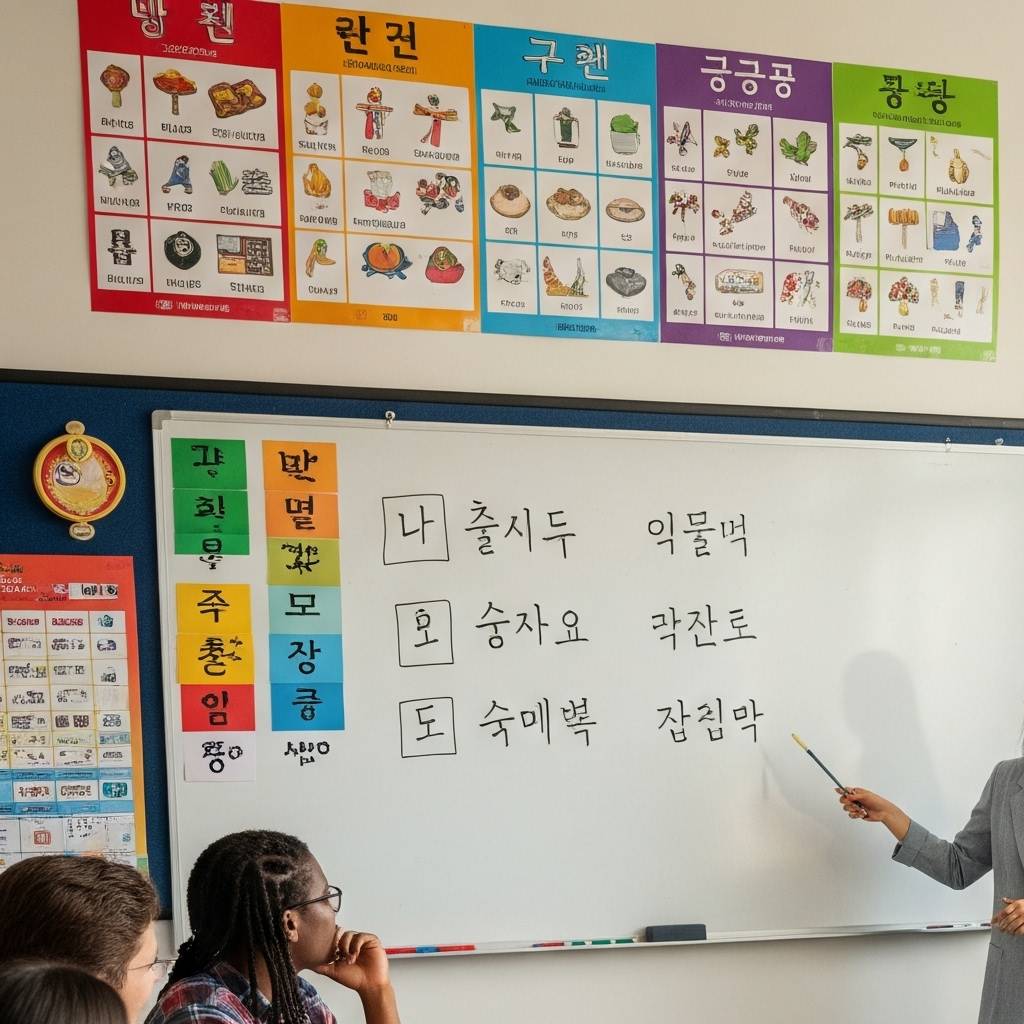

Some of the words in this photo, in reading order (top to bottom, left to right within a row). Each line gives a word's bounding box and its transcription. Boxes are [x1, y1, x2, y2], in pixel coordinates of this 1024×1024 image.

[522, 37, 565, 74] 구
[398, 504, 435, 545] 나
[648, 511, 747, 558] 익물먹
[197, 589, 230, 623] 주
[285, 593, 321, 616] 모
[475, 602, 590, 649] 숭자요
[288, 639, 321, 675] 장
[201, 691, 229, 726] 임
[415, 704, 445, 742] 도
